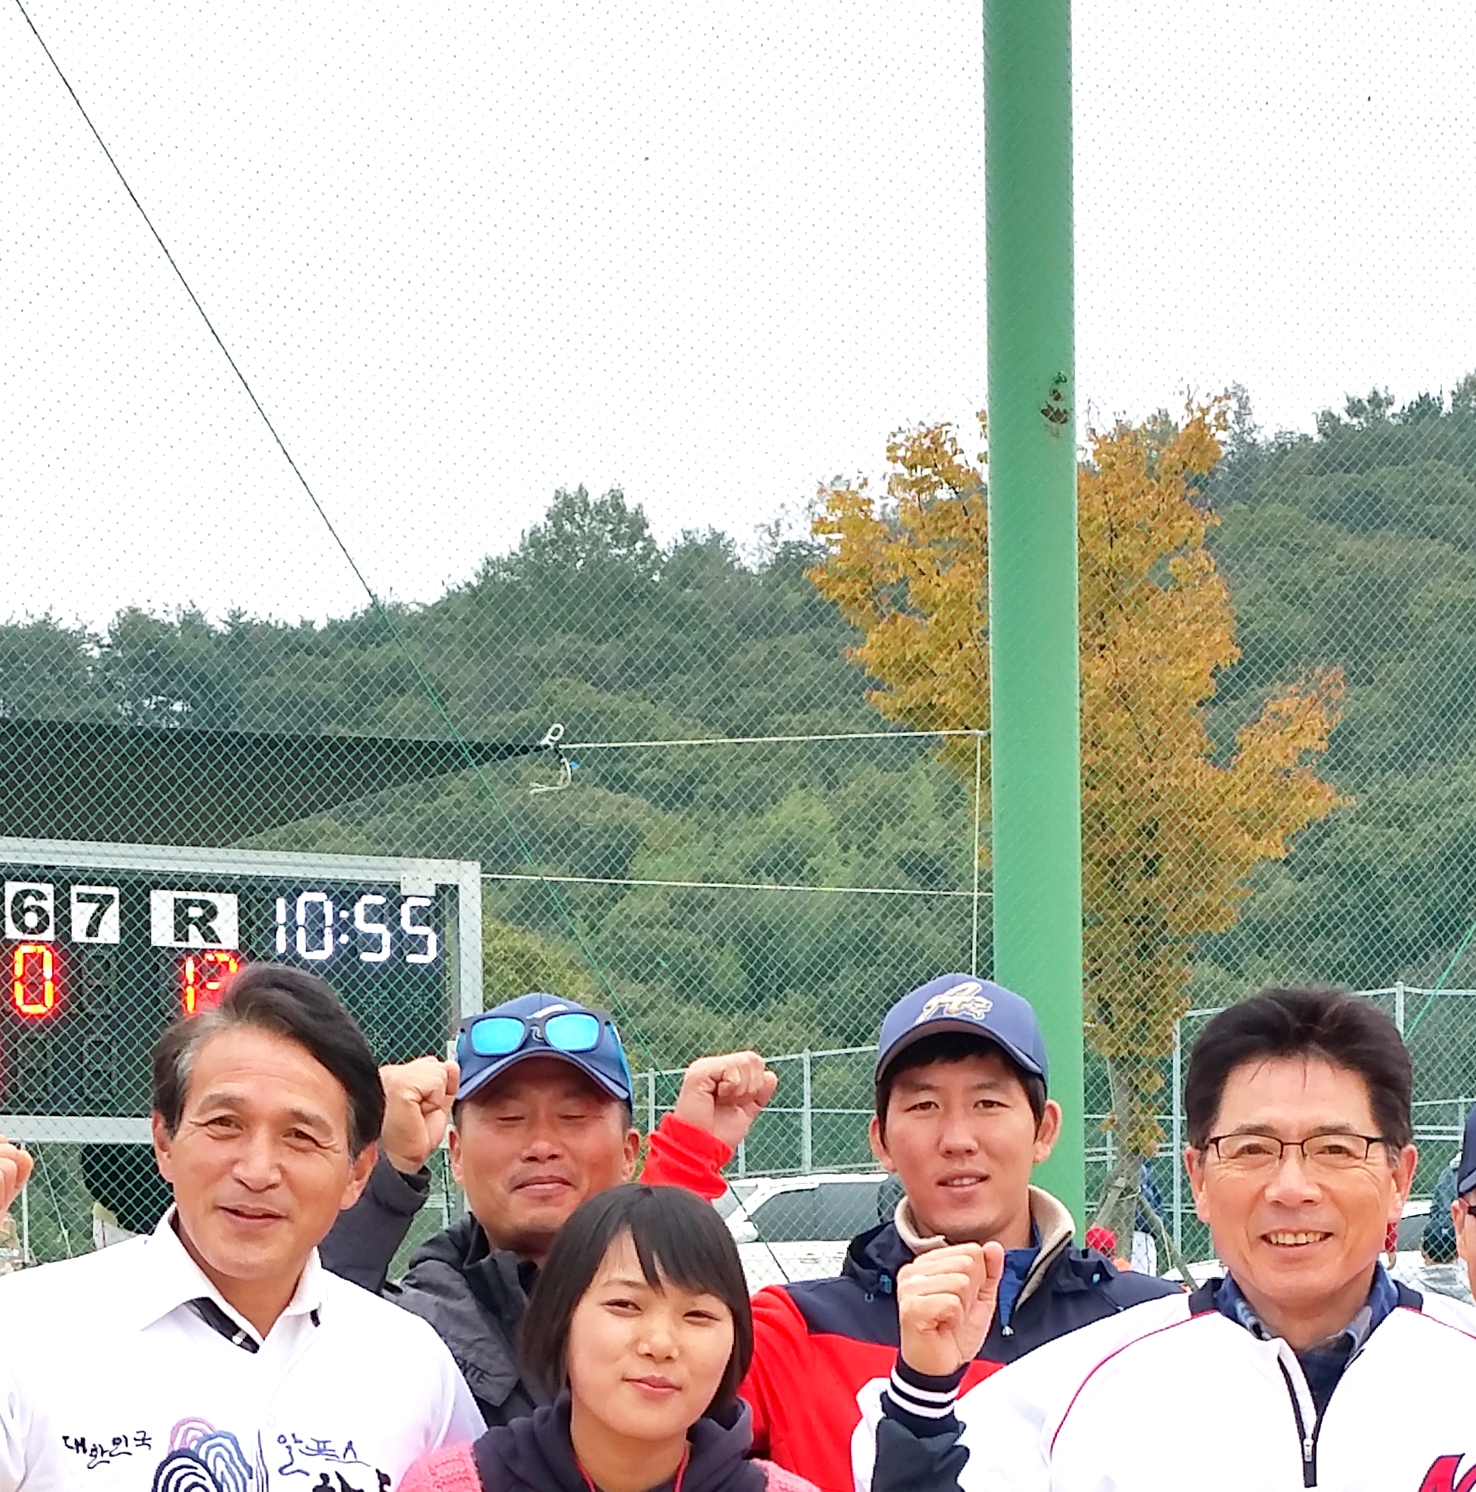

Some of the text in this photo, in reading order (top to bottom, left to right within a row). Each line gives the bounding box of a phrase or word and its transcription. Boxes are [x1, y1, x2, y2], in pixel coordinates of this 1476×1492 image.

[10, 889, 50, 936] 6
[76, 893, 115, 938] 7
[174, 898, 222, 944] R
[276, 892, 437, 963] 10:55
[14, 945, 54, 1015] 0
